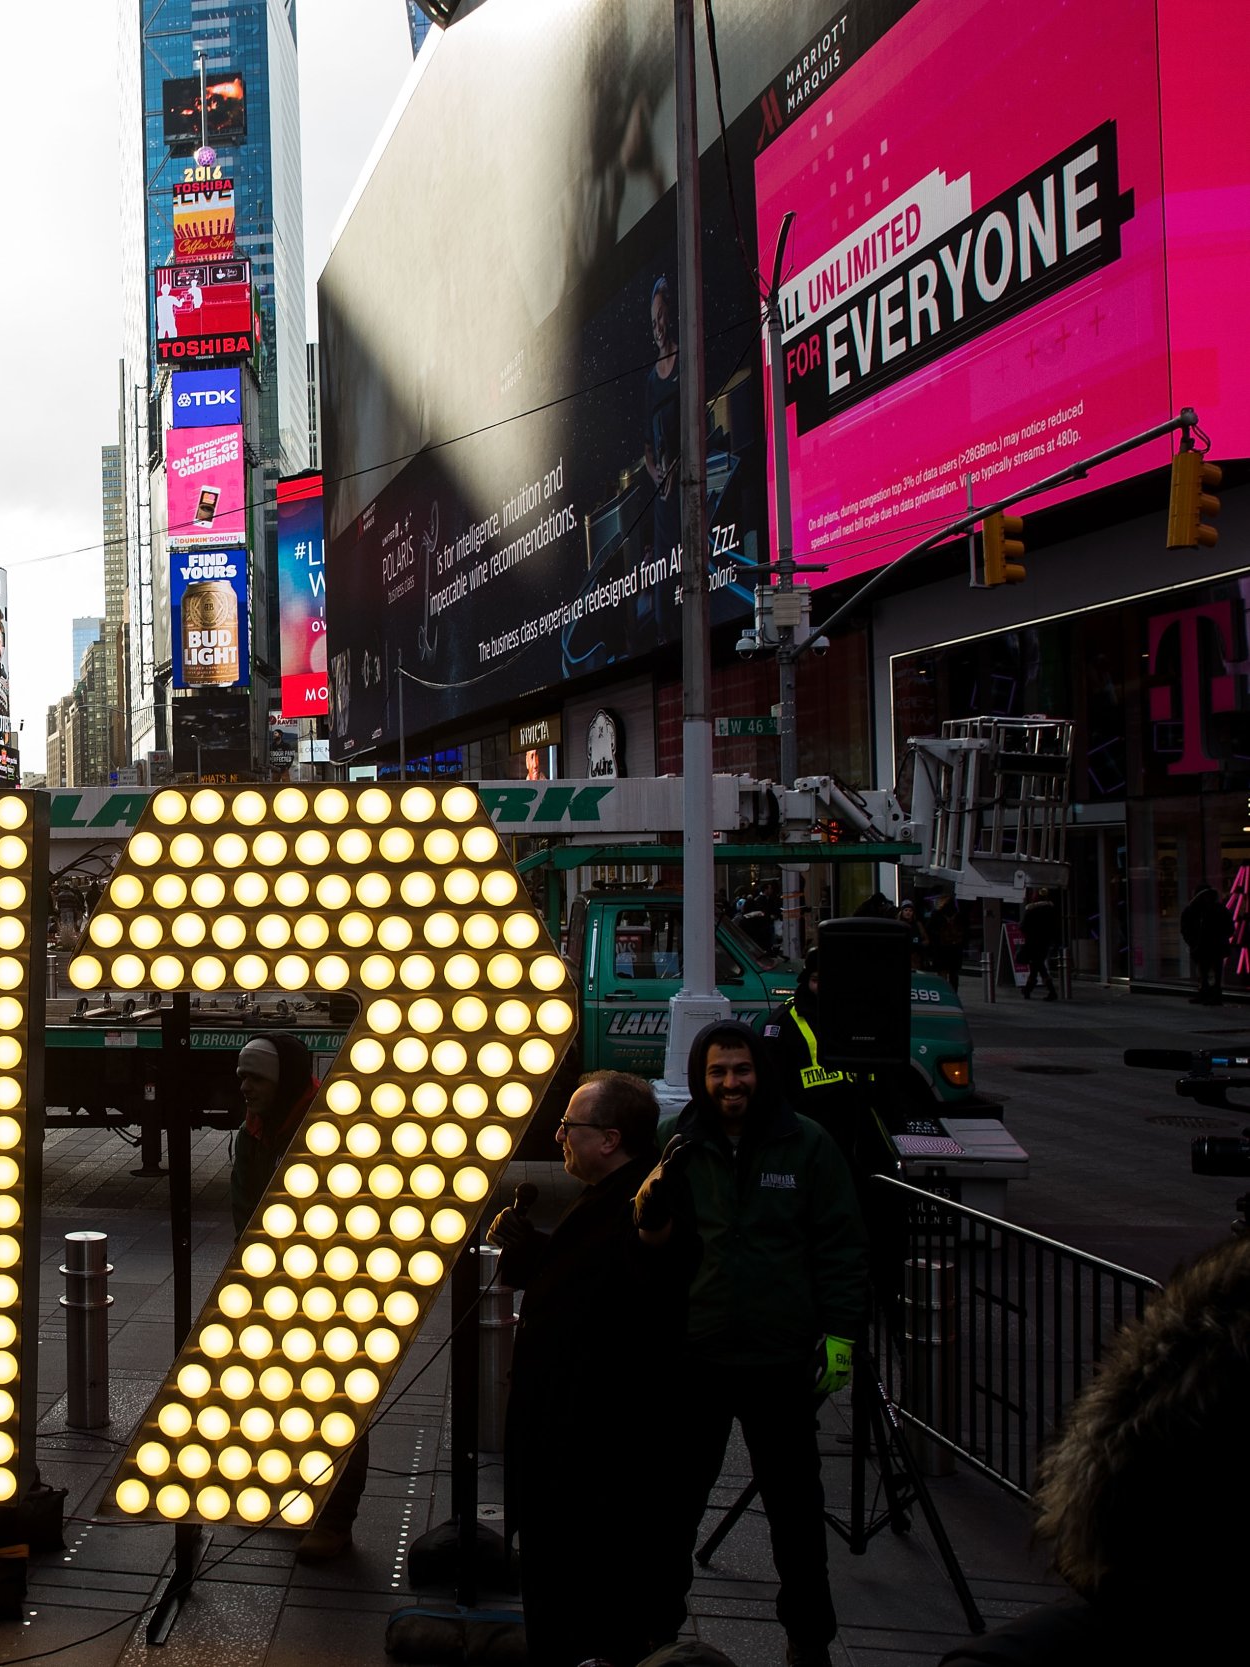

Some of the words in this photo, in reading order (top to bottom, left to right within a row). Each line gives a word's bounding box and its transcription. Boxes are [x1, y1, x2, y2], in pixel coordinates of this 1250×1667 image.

[786, 15, 849, 90] MARRIOTT
[787, 49, 842, 115] MARQUIS
[174, 179, 232, 193] TOSHIBA
[184, 166, 222, 183] 2016
[178, 239, 210, 255] Coffee
[210, 236, 234, 251] Shop
[787, 334, 821, 384] FOR
[827, 144, 1101, 395] EVERYONE
[809, 203, 921, 313] UNLIMITED
[159, 337, 250, 357] TOSHIBA
[190, 389, 236, 406] TDK
[172, 441, 239, 469] ON-THE-GO
[187, 432, 238, 455] INTRODUCING
[178, 451, 238, 477] ORDERING
[841, 502, 859, 517] during
[859, 487, 891, 509] congestion
[891, 482, 903, 496] top
[903, 475, 915, 491] 3%
[916, 470, 923, 486] of
[923, 467, 938, 482] data
[939, 459, 958, 476] users
[1003, 432, 1021, 448] may
[1021, 419, 1046, 440] notice
[1048, 399, 1084, 428] reduced
[811, 533, 829, 550] speeds
[830, 526, 841, 541] until
[842, 522, 854, 537] next
[854, 518, 864, 533] bill
[864, 511, 880, 528] cycle
[880, 506, 892, 521] due
[892, 503, 900, 516] to
[900, 497, 915, 513] data
[915, 480, 959, 509] prioritization.
[981, 454, 1011, 482] typically
[1013, 442, 1045, 467] streams
[1046, 439, 1055, 453] at
[1056, 427, 1082, 448] 480p.
[437, 551, 443, 576] is
[444, 544, 455, 571] for
[456, 512, 501, 562] intelligence,
[502, 481, 541, 529] intuition
[543, 456, 564, 500] and
[189, 553, 227, 567] FIND
[430, 570, 468, 617] impeccable
[469, 560, 489, 592] wine
[489, 503, 578, 580] recommendations.
[180, 565, 237, 580] YOURS
[478, 640, 491, 663] The
[491, 627, 520, 657] business
[521, 620, 538, 645] class
[539, 599, 583, 636] experience
[584, 566, 637, 616] redesigned
[639, 556, 667, 590] from
[188, 631, 231, 648] BUD
[184, 647, 237, 665] LIGHT
[520, 720, 549, 747] INVICTA
[731, 720, 741, 733] W
[748, 720, 763, 733] 46
[305, 1035, 321, 1046] NY
